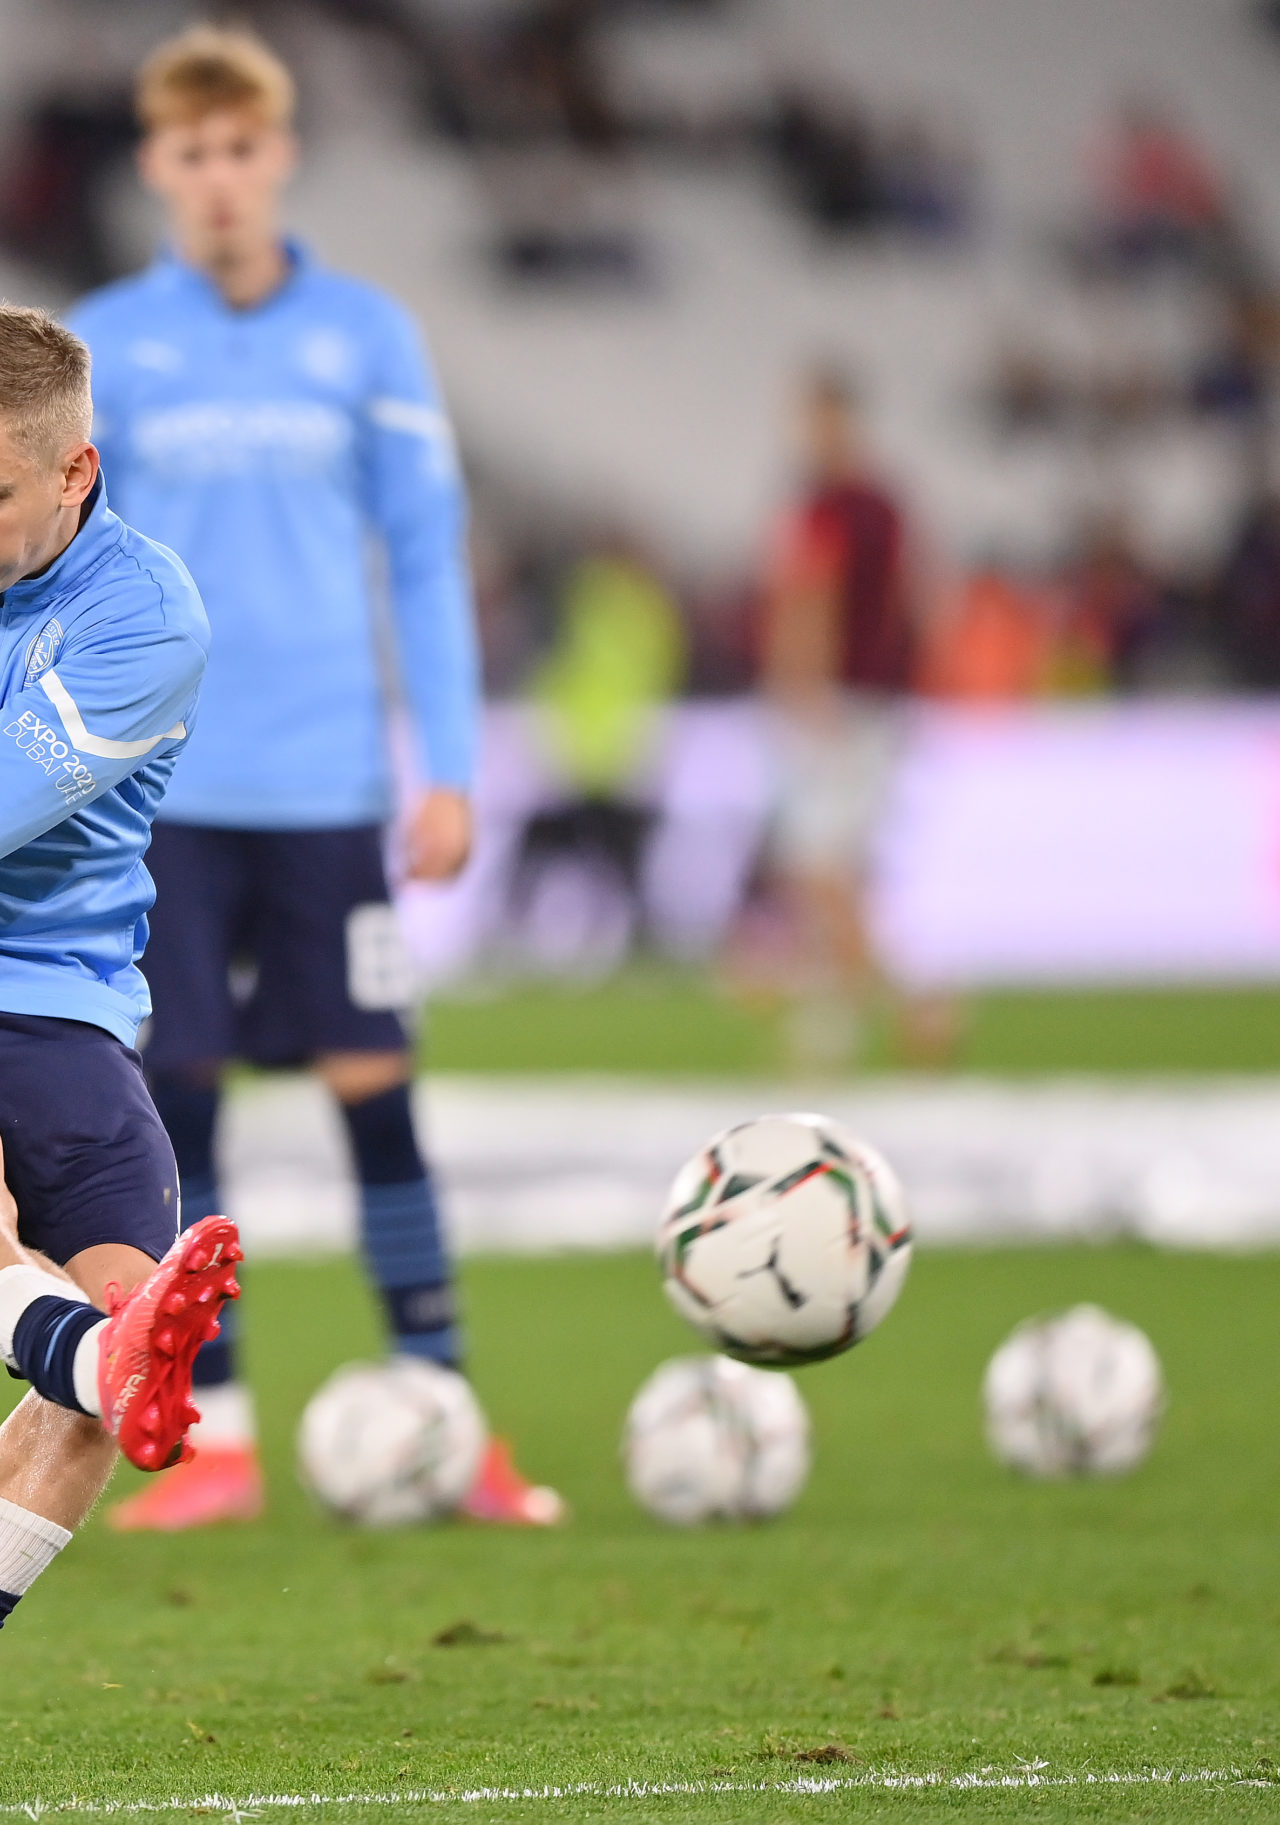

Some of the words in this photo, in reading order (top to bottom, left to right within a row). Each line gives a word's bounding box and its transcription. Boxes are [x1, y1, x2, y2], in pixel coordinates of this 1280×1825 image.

[3, 721, 61, 776] DUBAI
[55, 773, 83, 805] UAE
[17, 710, 69, 759] EXPO
[62, 754, 97, 795] 2020
